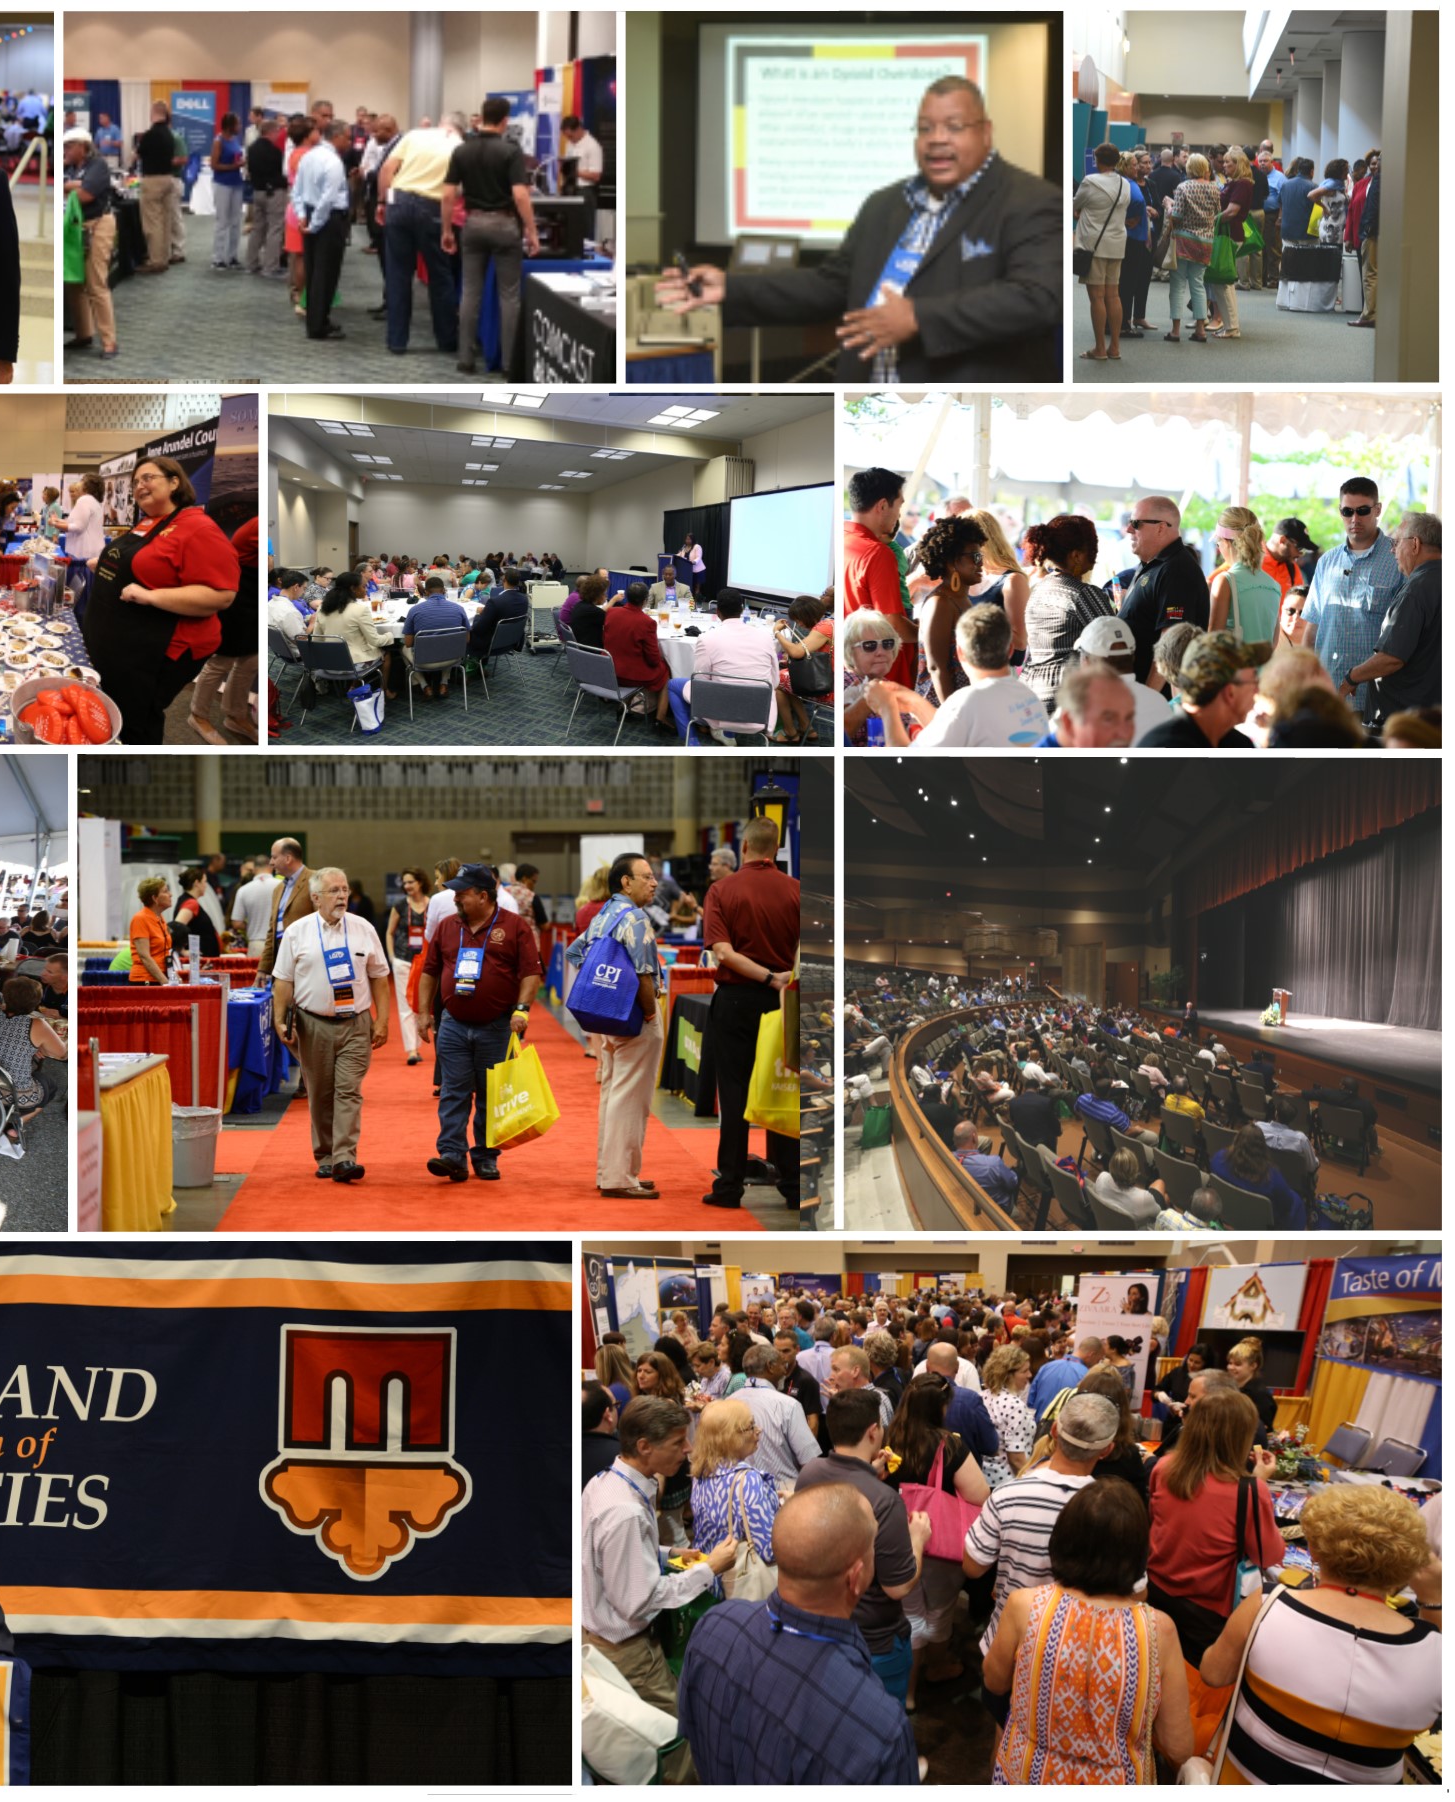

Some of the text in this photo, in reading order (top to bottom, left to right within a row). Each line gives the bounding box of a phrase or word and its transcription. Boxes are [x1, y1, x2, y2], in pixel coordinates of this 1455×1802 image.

[175, 98, 210, 110] DELL
[533, 309, 595, 385] COMCAST
[162, 431, 194, 455] Arundel
[596, 963, 622, 984] CPJ
[1341, 1269, 1390, 1293] Taste
[1395, 1259, 1427, 1289] of
[16, 1427, 58, 1469] of
